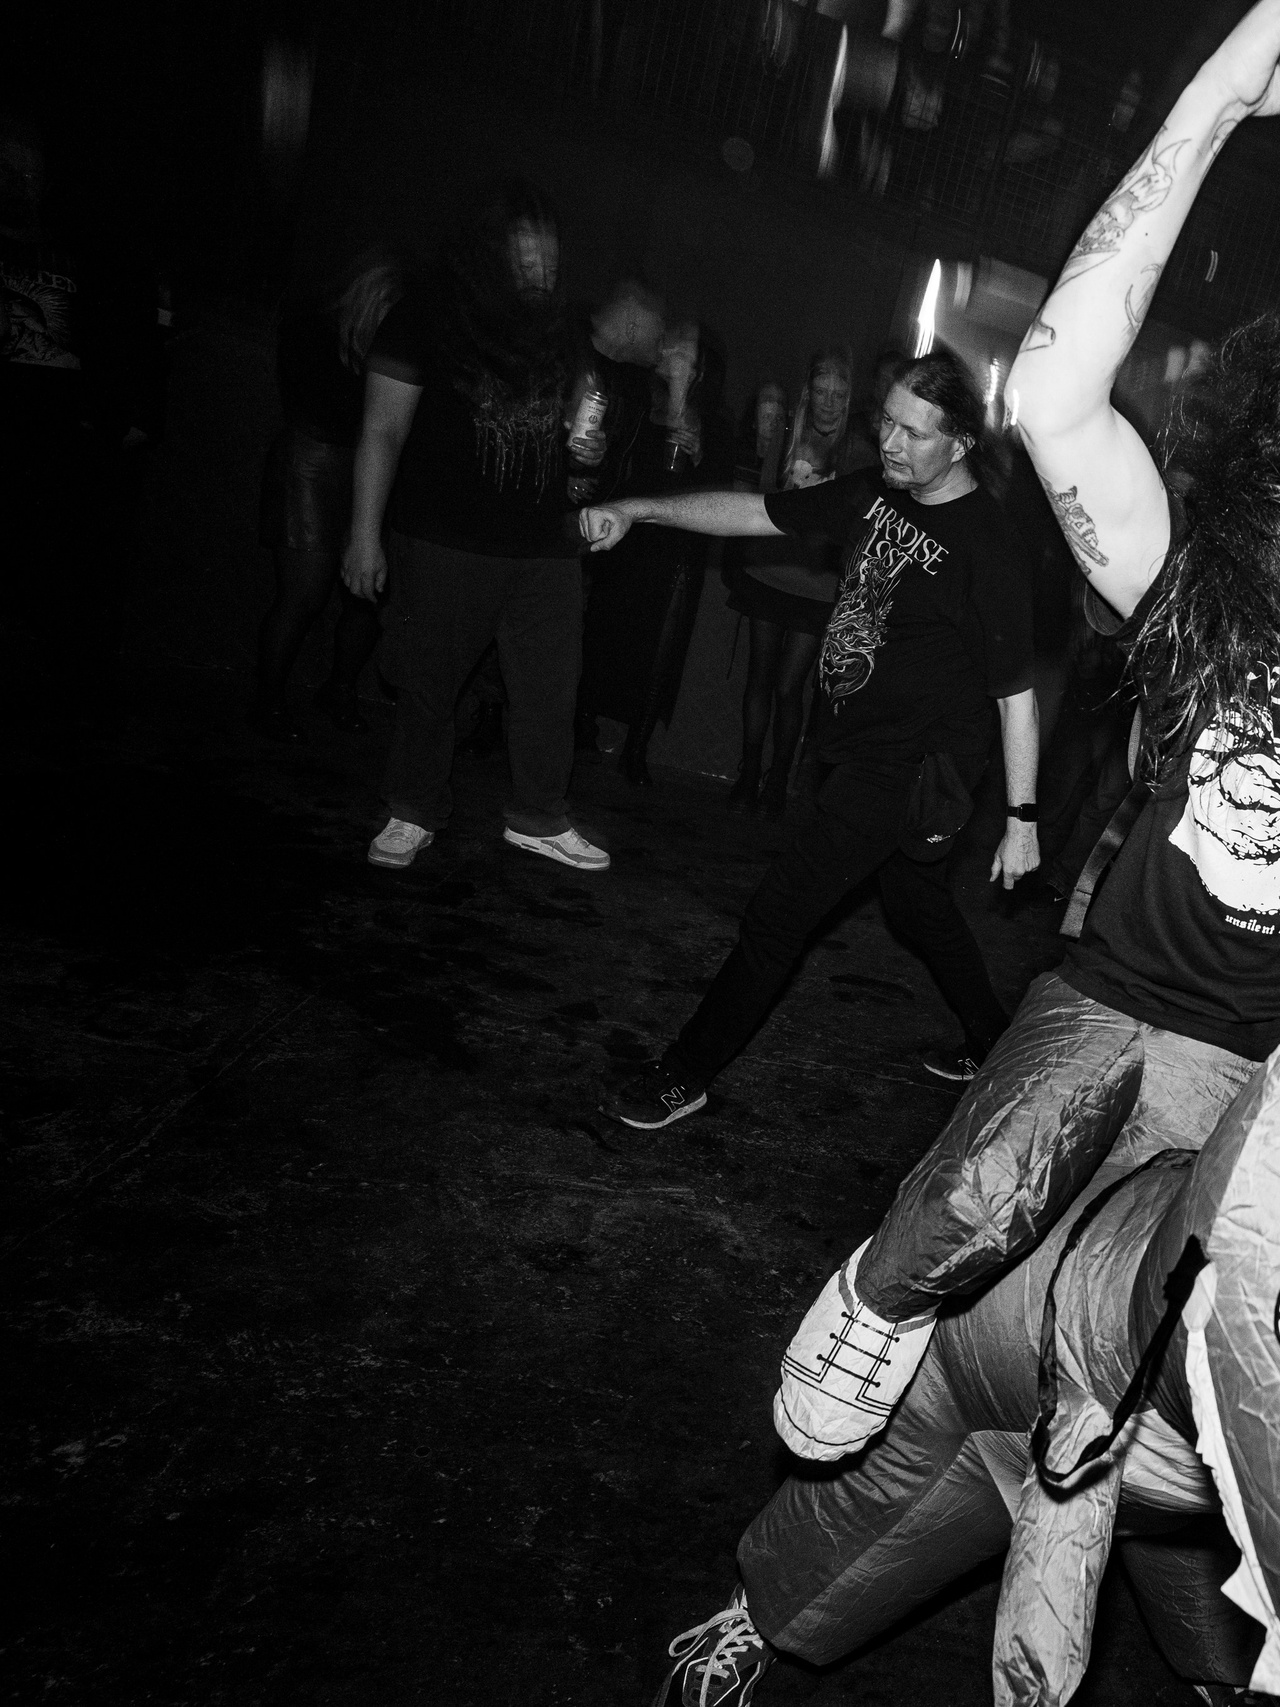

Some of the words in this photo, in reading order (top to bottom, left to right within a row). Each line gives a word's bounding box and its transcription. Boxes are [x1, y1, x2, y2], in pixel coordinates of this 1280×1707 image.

[862, 530, 913, 578] LOST
[1225, 914, 1276, 935] unsilent
[660, 1086, 686, 1113] N
